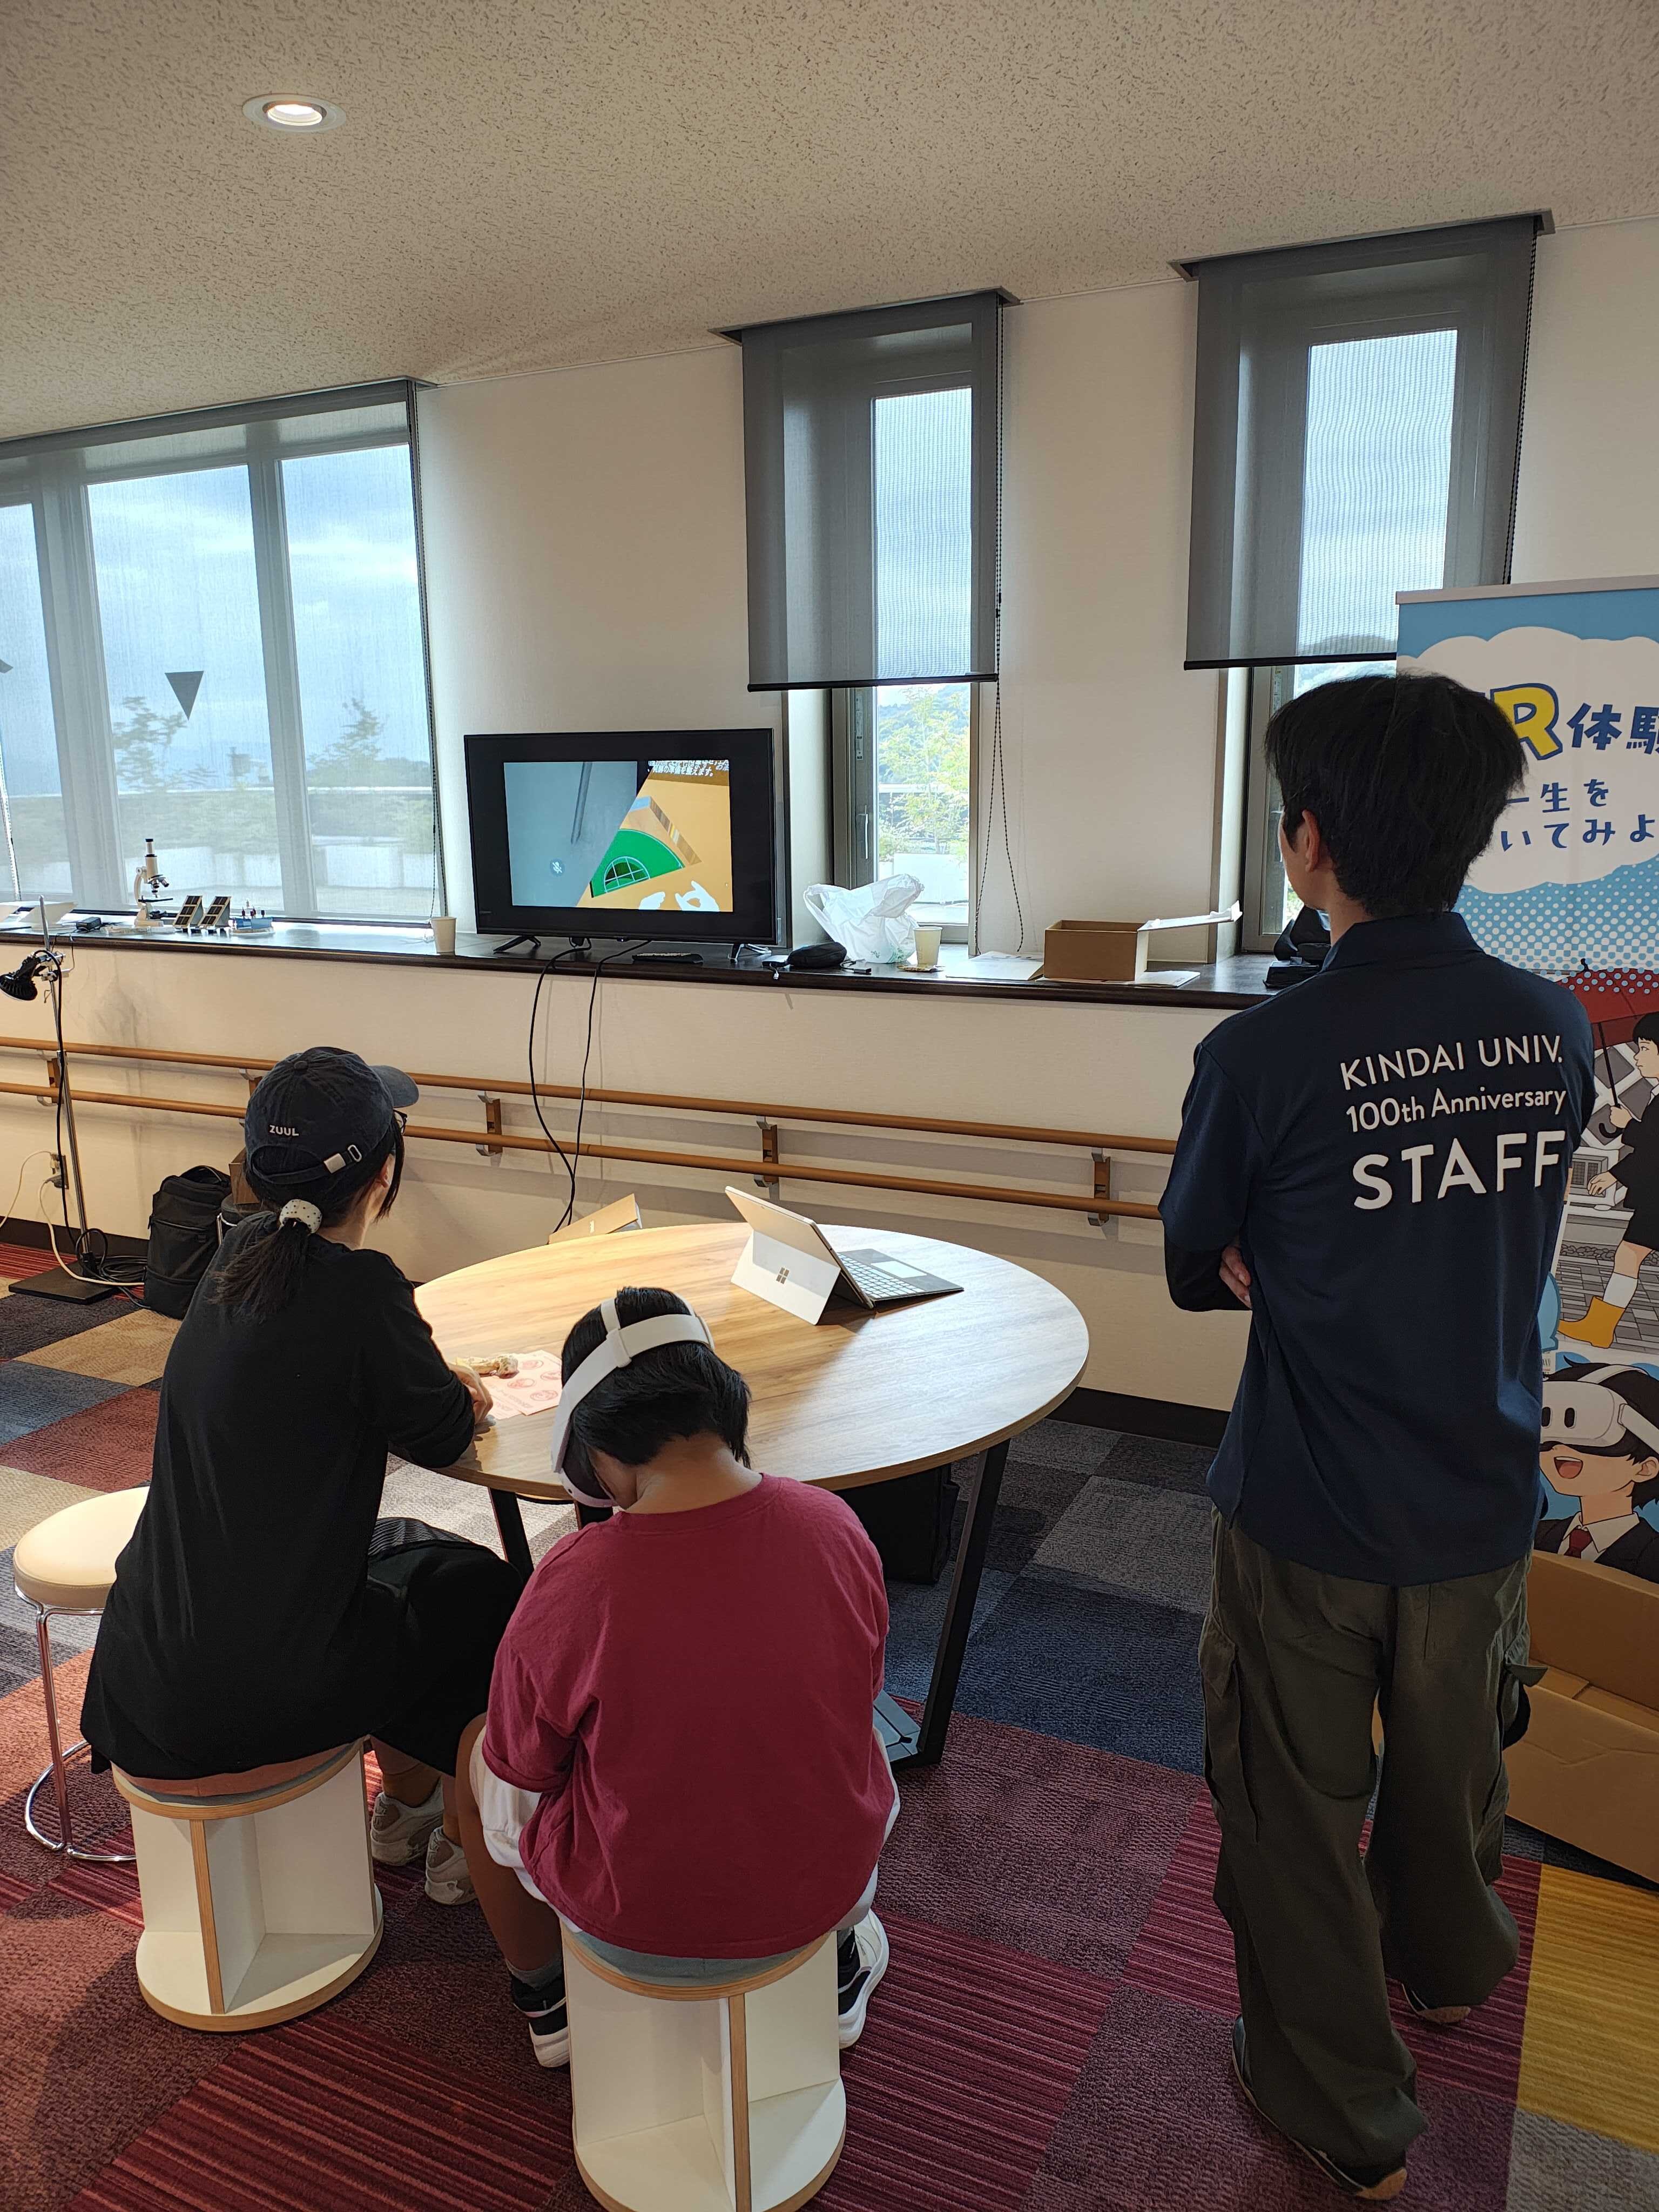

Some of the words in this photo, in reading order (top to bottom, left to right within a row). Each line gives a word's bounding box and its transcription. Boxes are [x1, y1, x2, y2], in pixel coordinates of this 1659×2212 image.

[1476, 683, 1659, 760] R体験
[1501, 814, 1655, 852] いてみよ
[1340, 1042, 1465, 1090] KINDAI
[1478, 1035, 1563, 1067] UNIV.
[269, 1124, 299, 1136] ZUUL
[1346, 1096, 1425, 1132] 100th
[1431, 1087, 1566, 1117] Anniversary
[1352, 1130, 1566, 1210] STAFF
